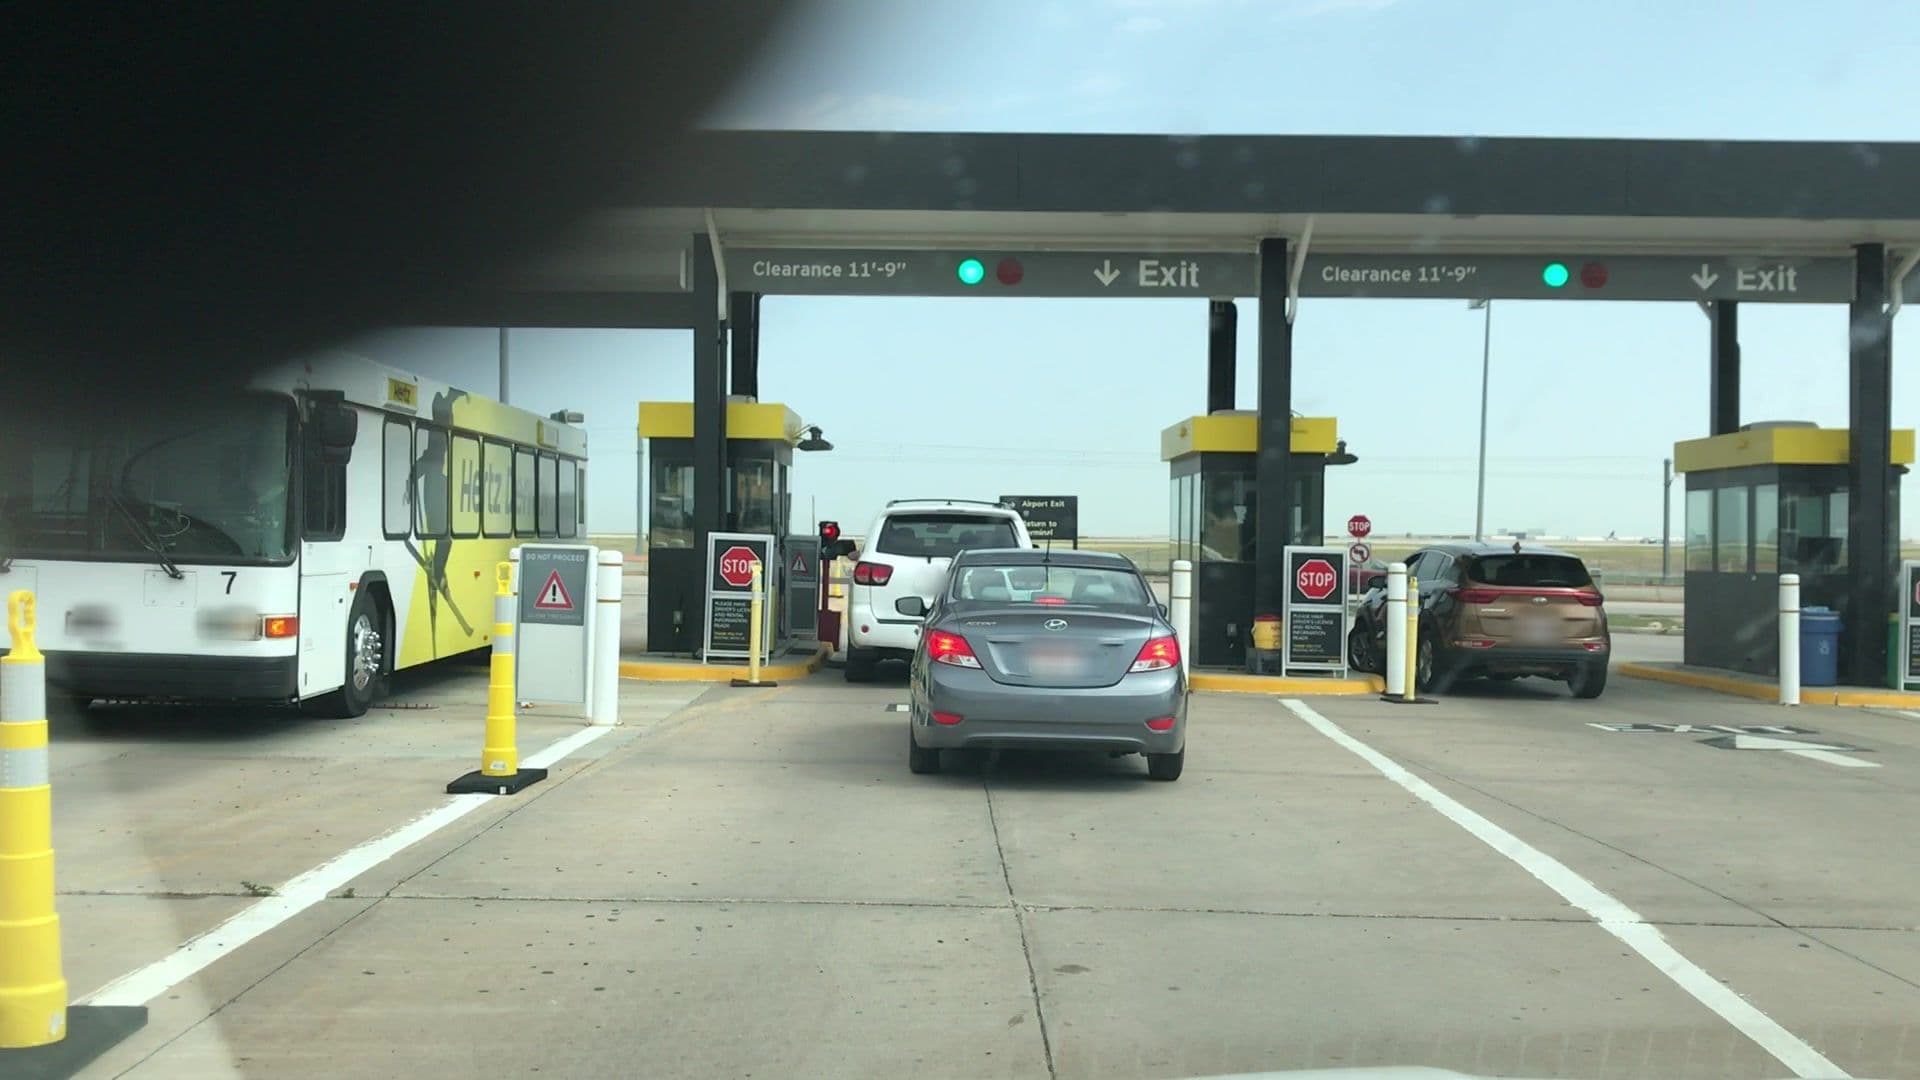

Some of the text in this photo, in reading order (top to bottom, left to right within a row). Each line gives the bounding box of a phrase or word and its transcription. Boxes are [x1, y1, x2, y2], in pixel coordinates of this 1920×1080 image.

[752, 260, 842, 278] Clearance
[1139, 259, 1200, 288] Exit
[1321, 265, 1412, 283] Clearance
[1736, 264, 1797, 292] Exit
[460, 458, 502, 514] Hertz
[1022, 499, 1065, 509] Airport Exit
[1049, 520, 1058, 528] to
[1349, 521, 1370, 531] STOP
[525, 552, 585, 562] DO NOT PROCEED
[220, 571, 237, 595] 7
[1300, 571, 1333, 587] STOP
